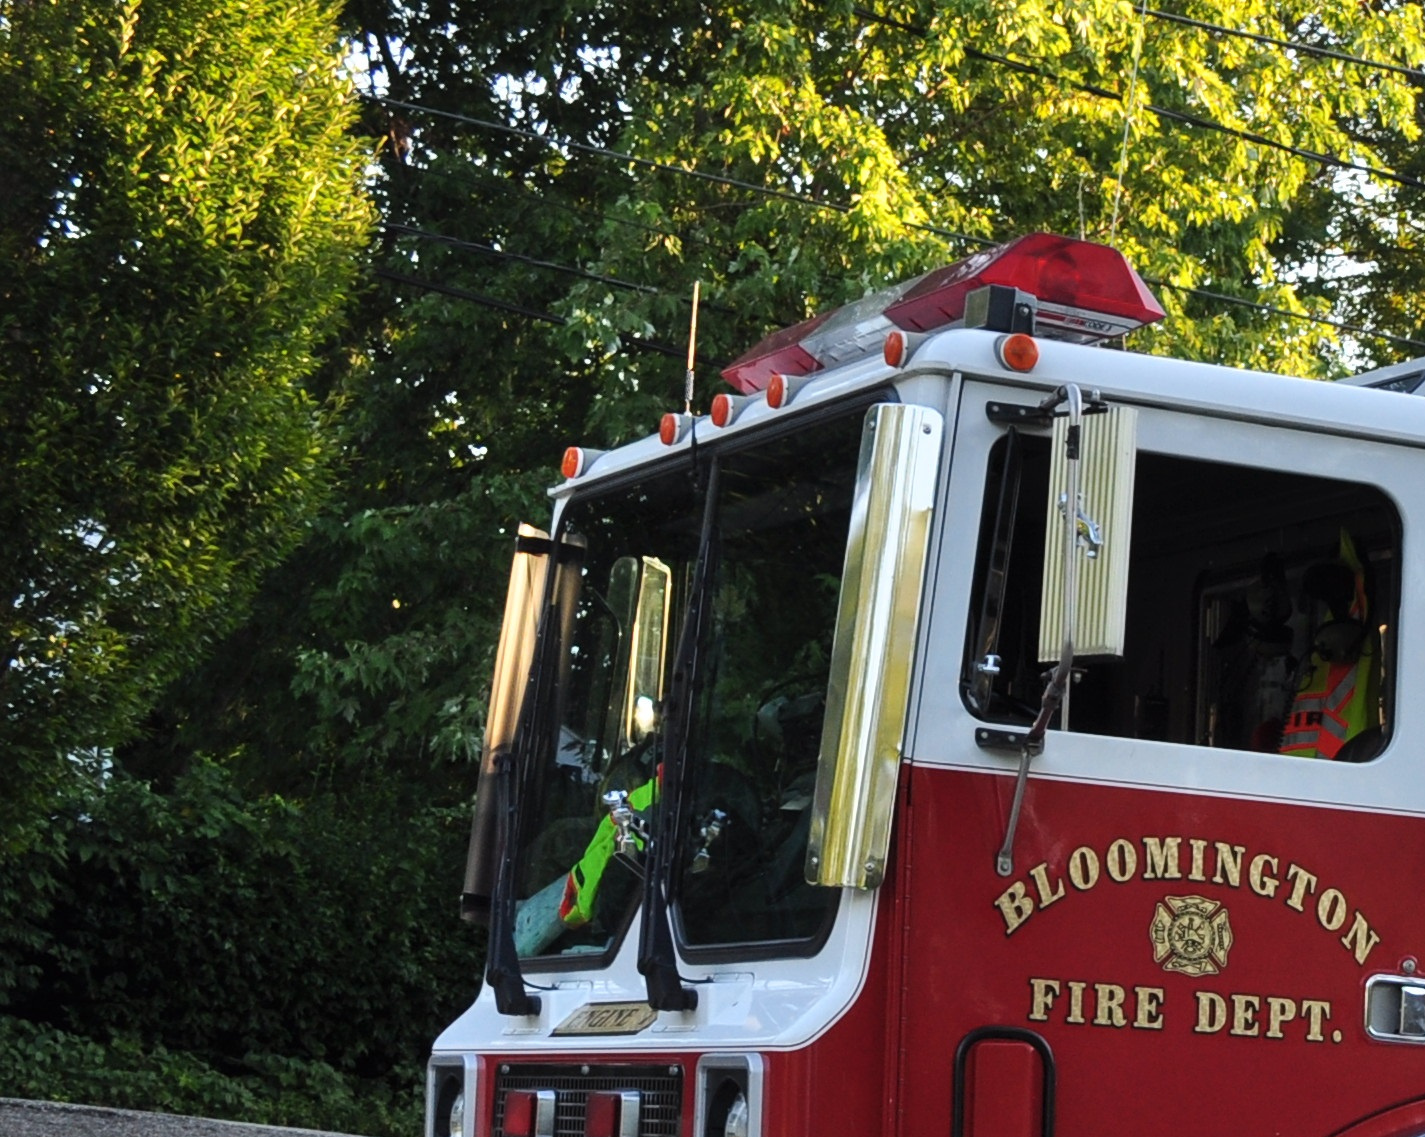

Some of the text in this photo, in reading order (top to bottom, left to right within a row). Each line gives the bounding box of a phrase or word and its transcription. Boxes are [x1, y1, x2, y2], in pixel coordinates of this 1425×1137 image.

[994, 837, 1380, 965] BLOOMINGTON
[567, 1008, 639, 1028] ENGINE
[1028, 978, 1343, 1043] FIRE DEPT.
